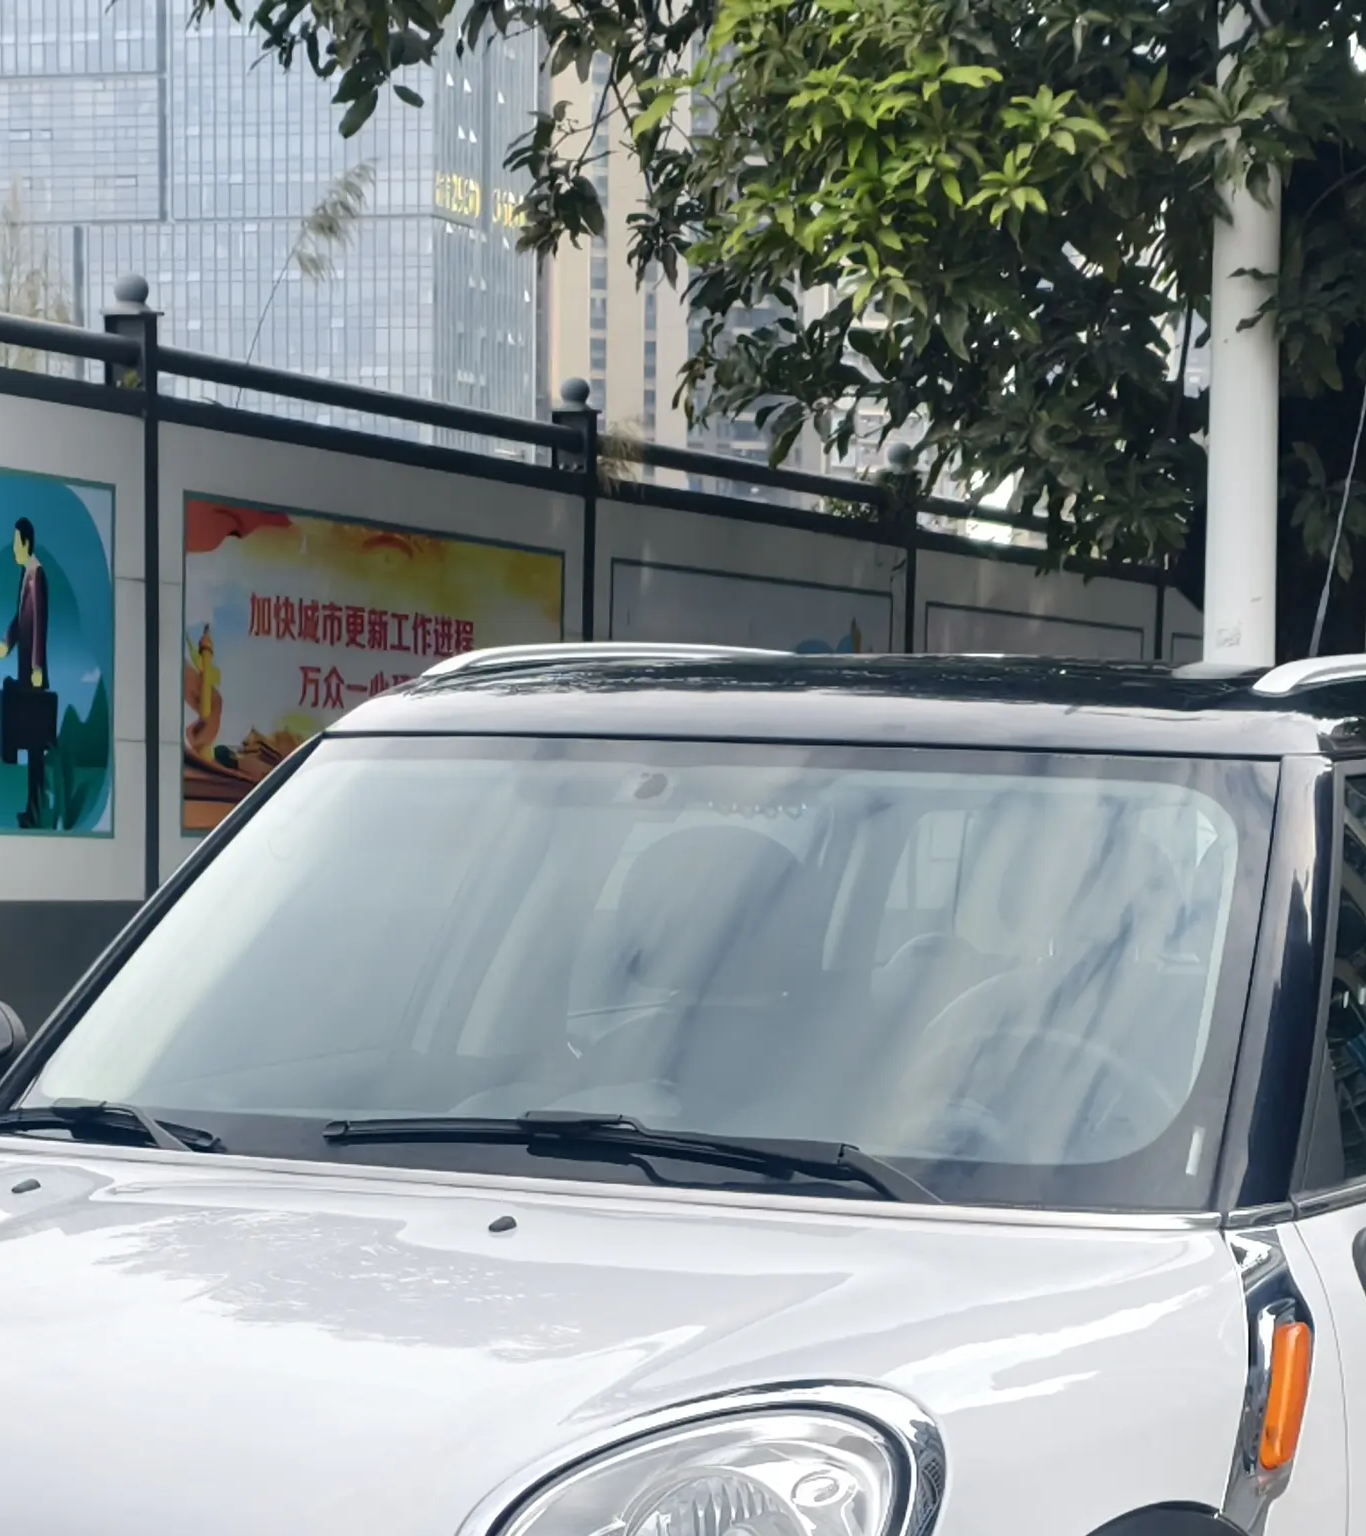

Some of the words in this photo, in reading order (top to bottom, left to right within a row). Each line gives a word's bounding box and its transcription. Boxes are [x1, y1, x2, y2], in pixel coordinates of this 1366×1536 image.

[248, 592, 474, 657] 加快城市更新工作进程
[299, 665, 411, 709] 万众一心
